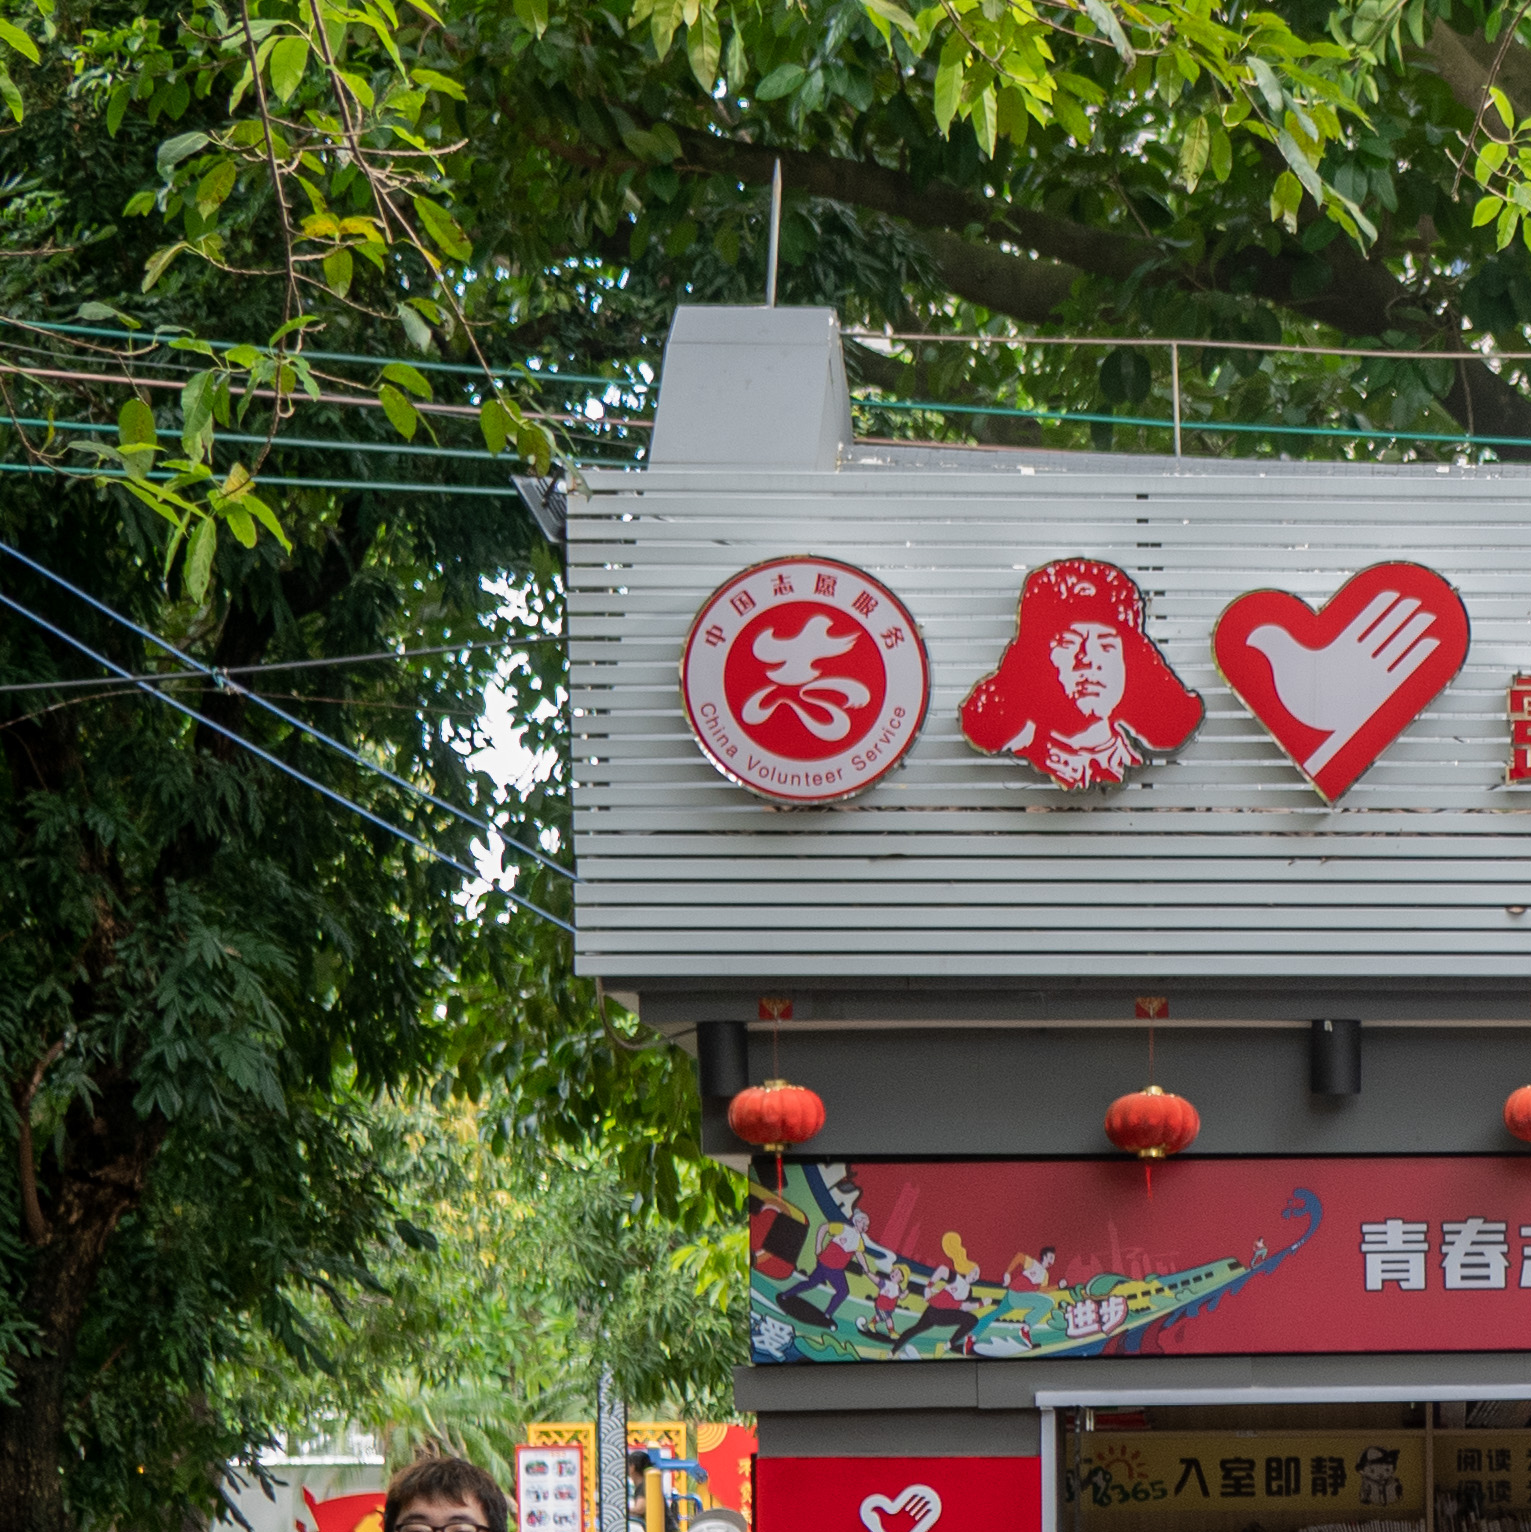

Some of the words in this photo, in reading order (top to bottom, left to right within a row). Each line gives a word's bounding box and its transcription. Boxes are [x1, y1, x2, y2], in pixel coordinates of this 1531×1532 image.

[704, 572, 905, 650] 中国志愿服务
[699, 702, 738, 759] China
[747, 755, 844, 788] Volunteer
[850, 705, 907, 772] Service
[1173, 1456, 1348, 1498] 入室即静
